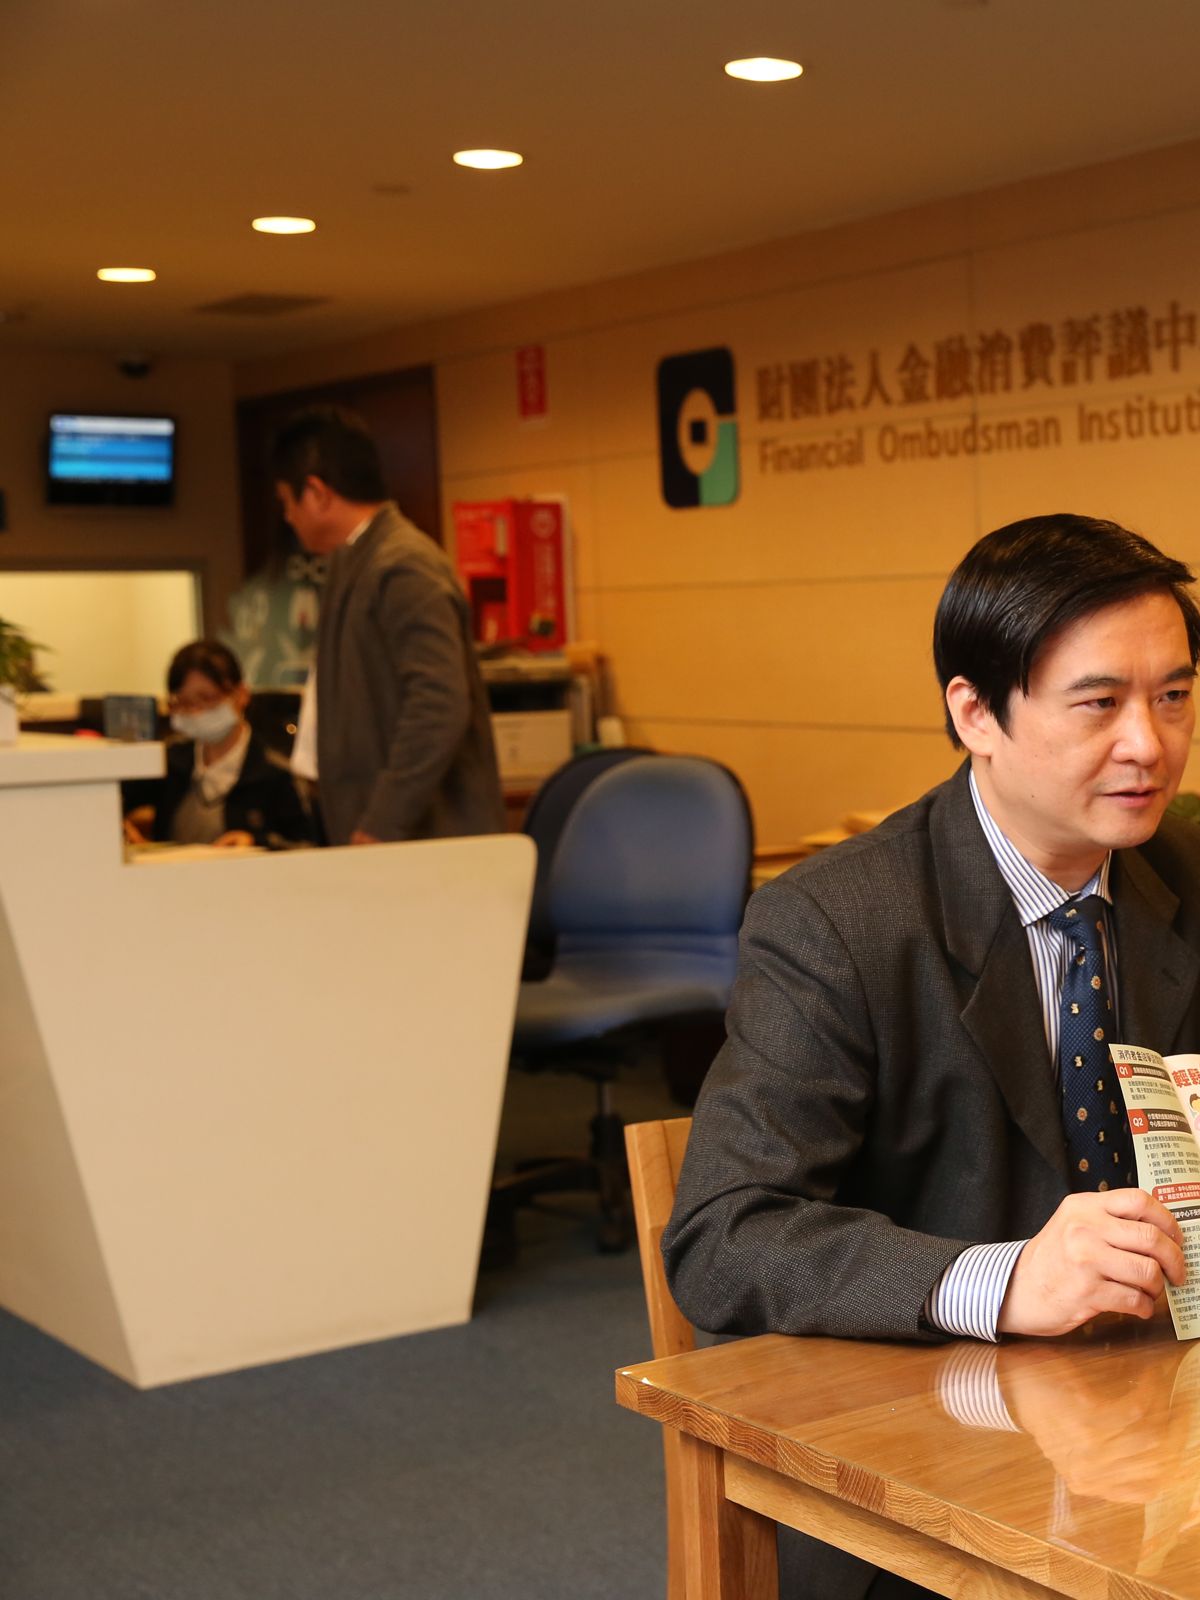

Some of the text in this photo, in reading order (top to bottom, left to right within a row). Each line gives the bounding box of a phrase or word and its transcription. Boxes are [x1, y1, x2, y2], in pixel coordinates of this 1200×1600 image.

[758, 429, 865, 475] Financial
[878, 409, 1061, 463] Ombudsman
[1132, 1117, 1144, 1127] Q2
